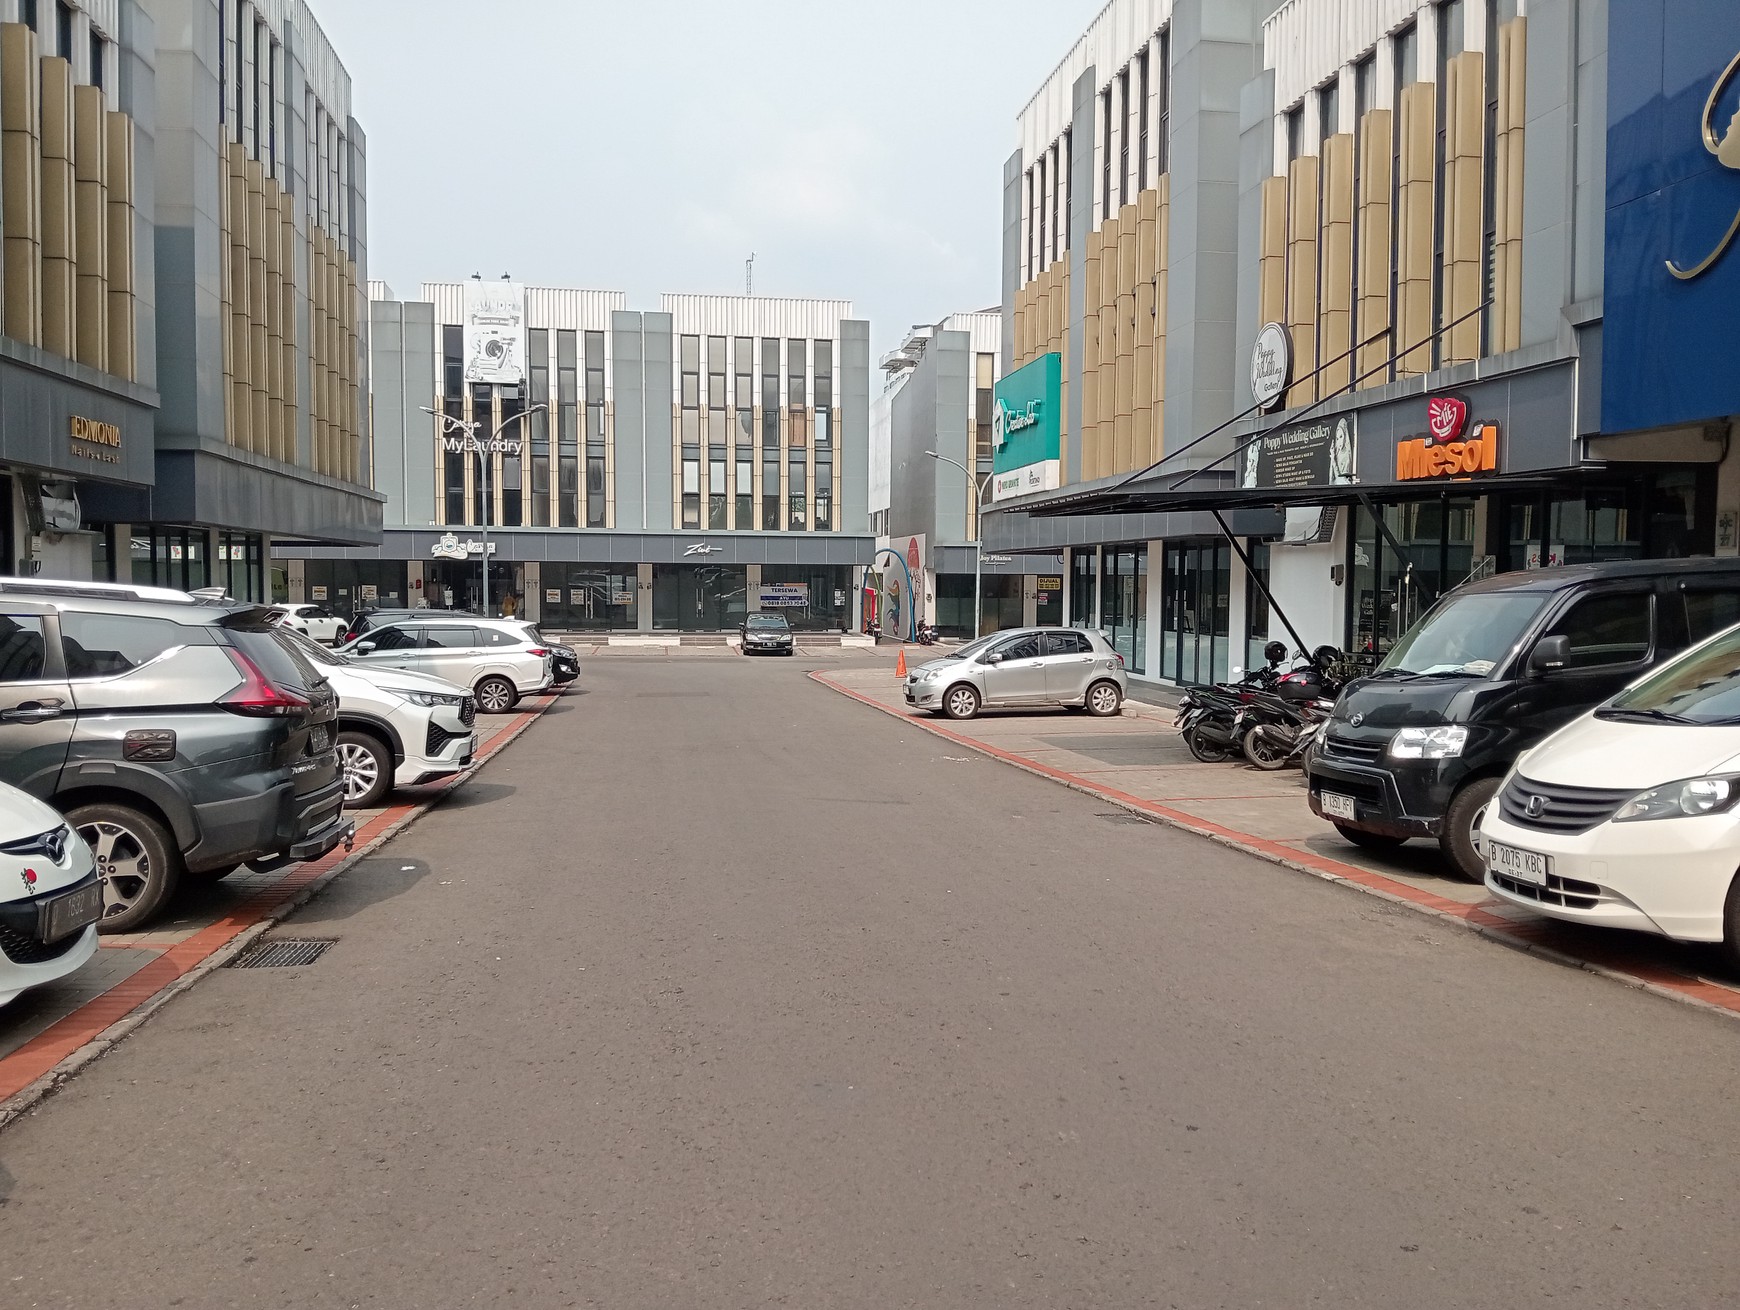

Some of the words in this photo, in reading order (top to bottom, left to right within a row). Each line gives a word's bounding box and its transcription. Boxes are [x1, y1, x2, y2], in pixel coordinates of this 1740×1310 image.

[70, 415, 122, 448] EDMONIA
[1263, 436, 1281, 450] Poppy
[1282, 429, 1309, 444] Wedding
[1309, 425, 1332, 440] Gallery
[442, 437, 523, 455] MyLaundry
[1322, 792, 1328, 807] B
[1491, 844, 1497, 861] B
[1500, 847, 1521, 868] 2075
[1524, 852, 1543, 874] KBC
